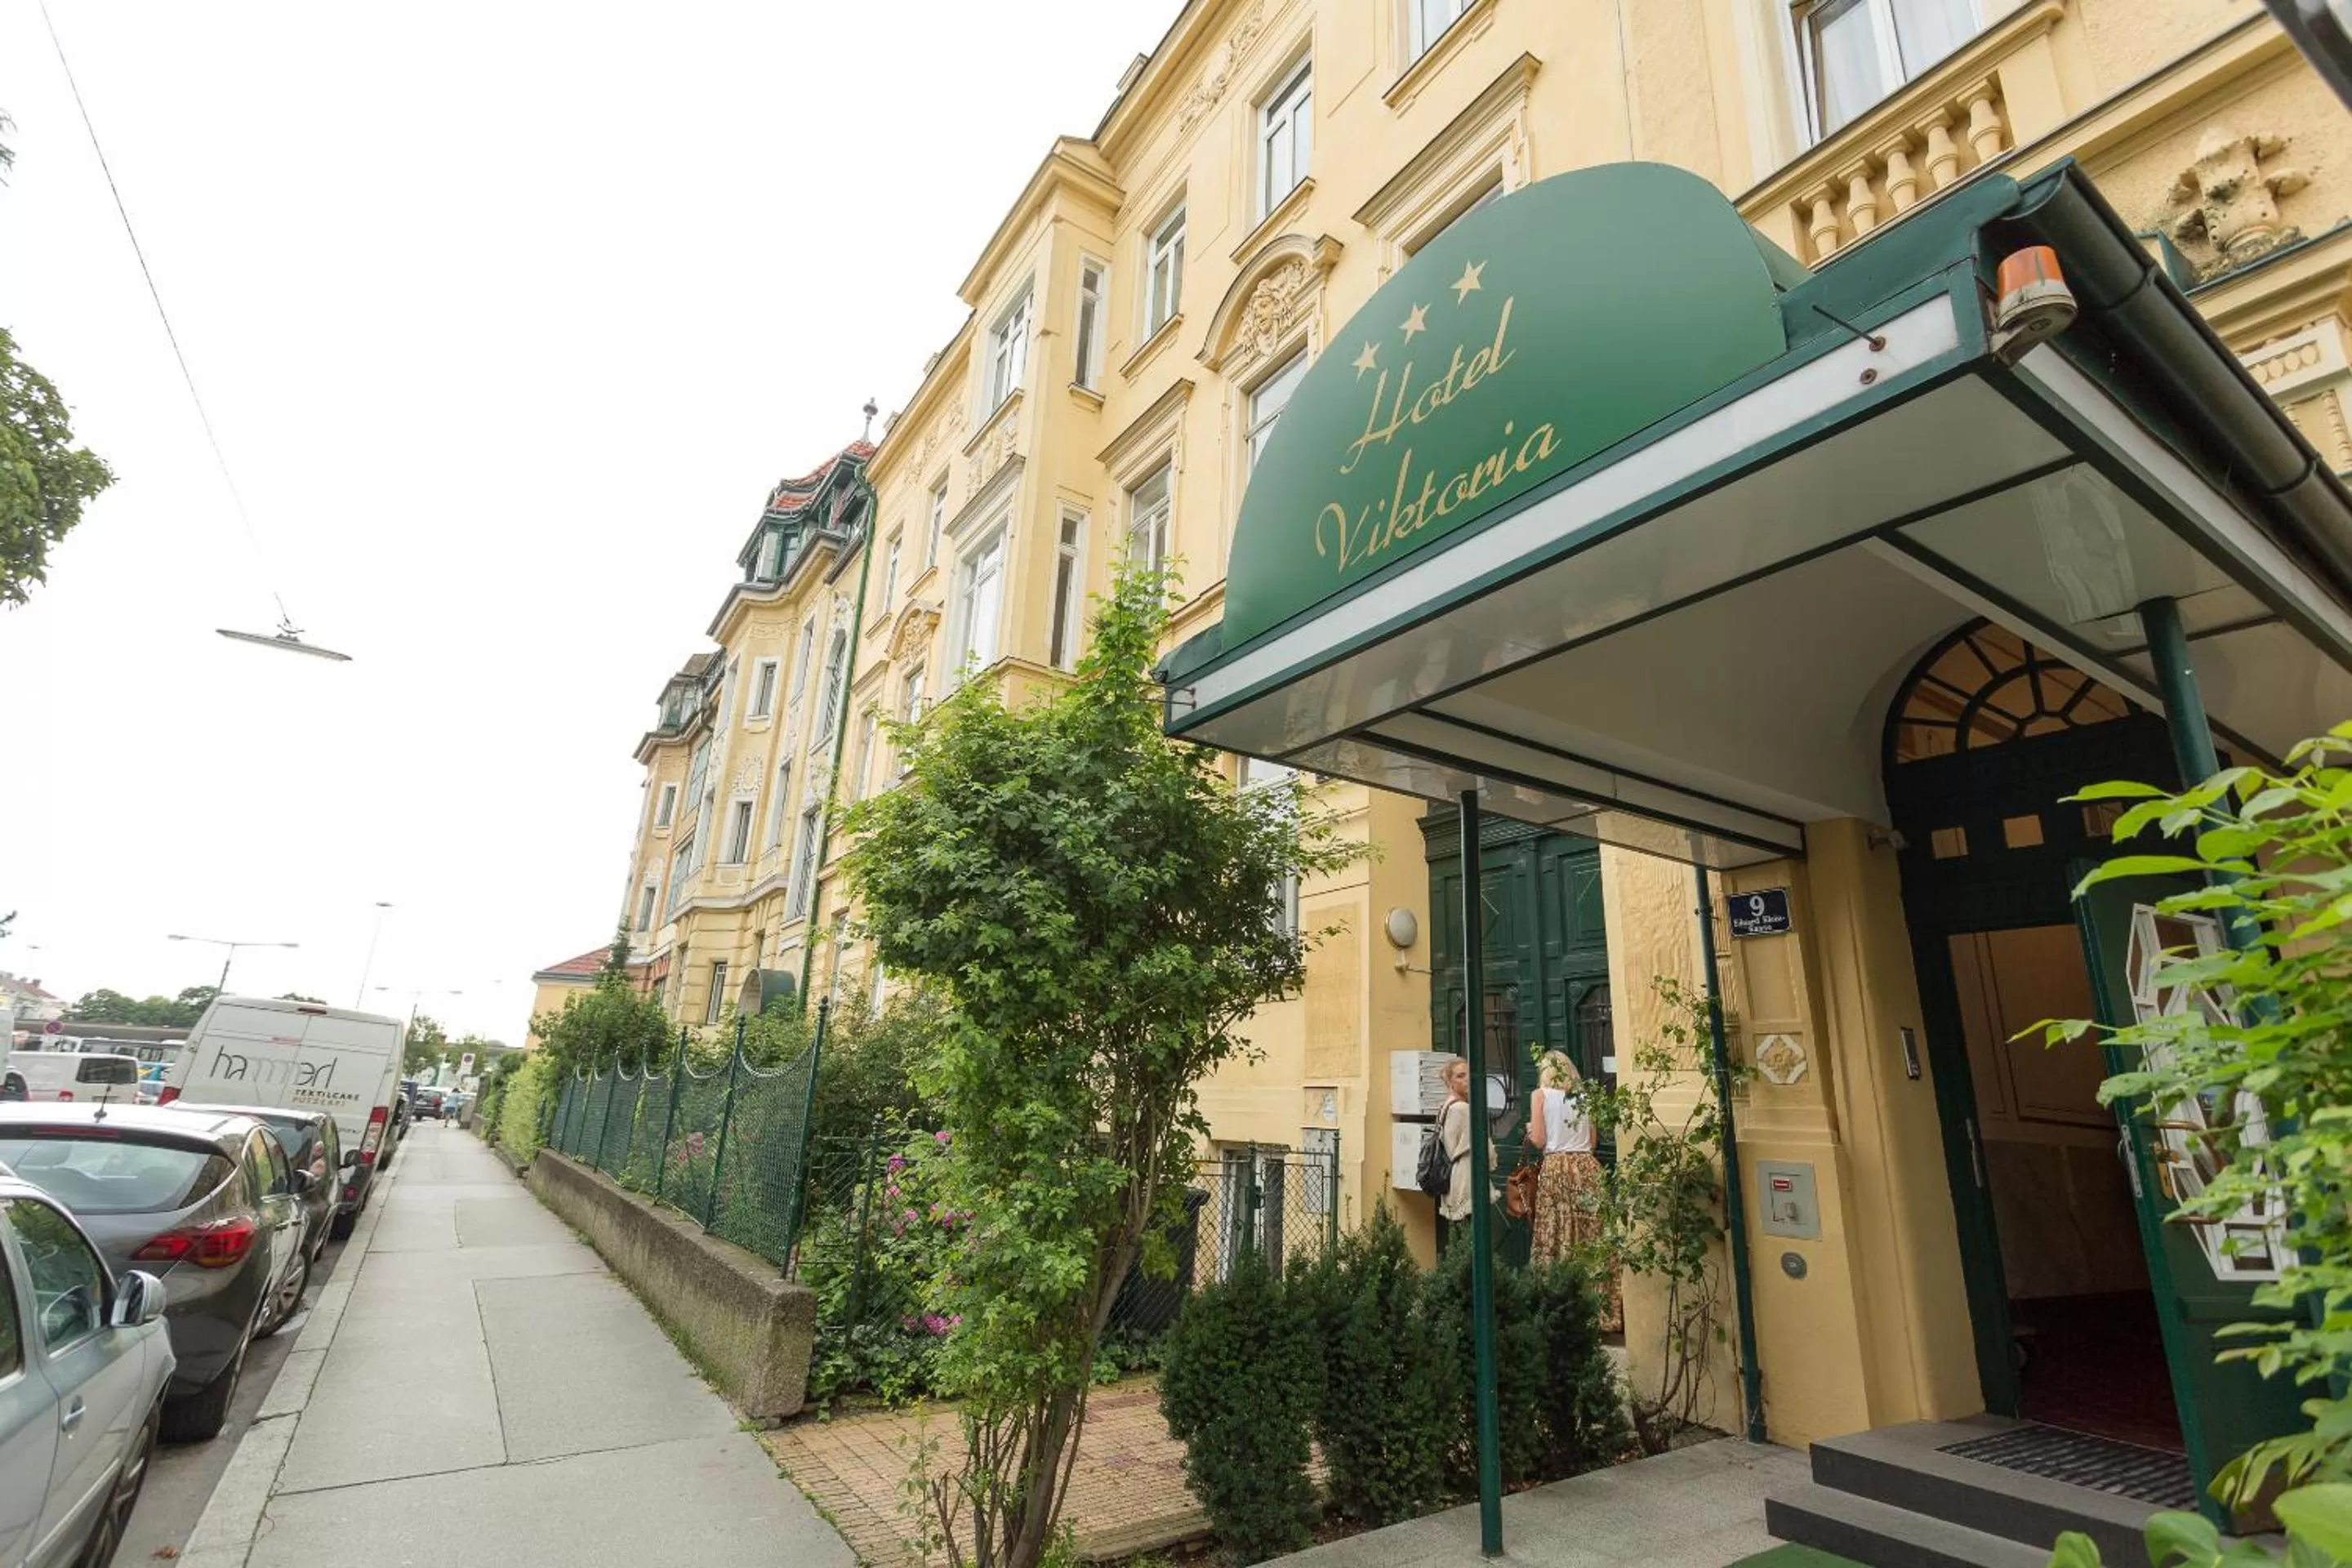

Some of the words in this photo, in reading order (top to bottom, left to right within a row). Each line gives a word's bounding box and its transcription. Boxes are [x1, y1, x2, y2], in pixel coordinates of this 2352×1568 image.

[1339, 295, 1517, 475] Hotel
[1315, 421, 1562, 574] Viktoria
[1749, 895, 1764, 916] 9
